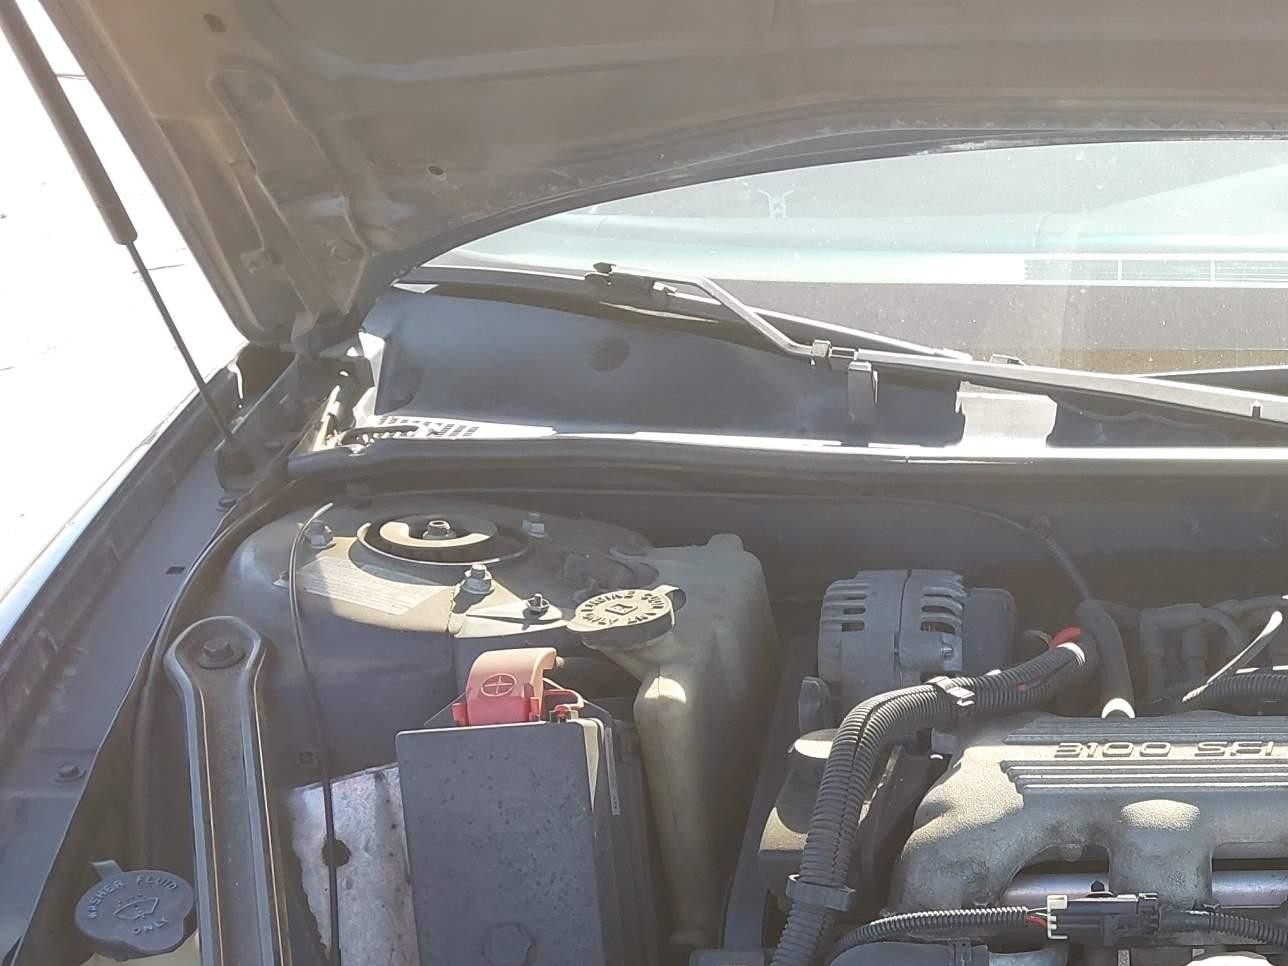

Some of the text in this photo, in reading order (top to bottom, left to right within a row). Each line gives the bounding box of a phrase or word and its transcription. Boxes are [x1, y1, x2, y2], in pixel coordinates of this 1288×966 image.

[1054, 742, 1171, 758] 3100
[1194, 741, 1276, 758] SFI
[87, 874, 178, 919] WASHER FLUID
[131, 916, 169, 935] ONLY
